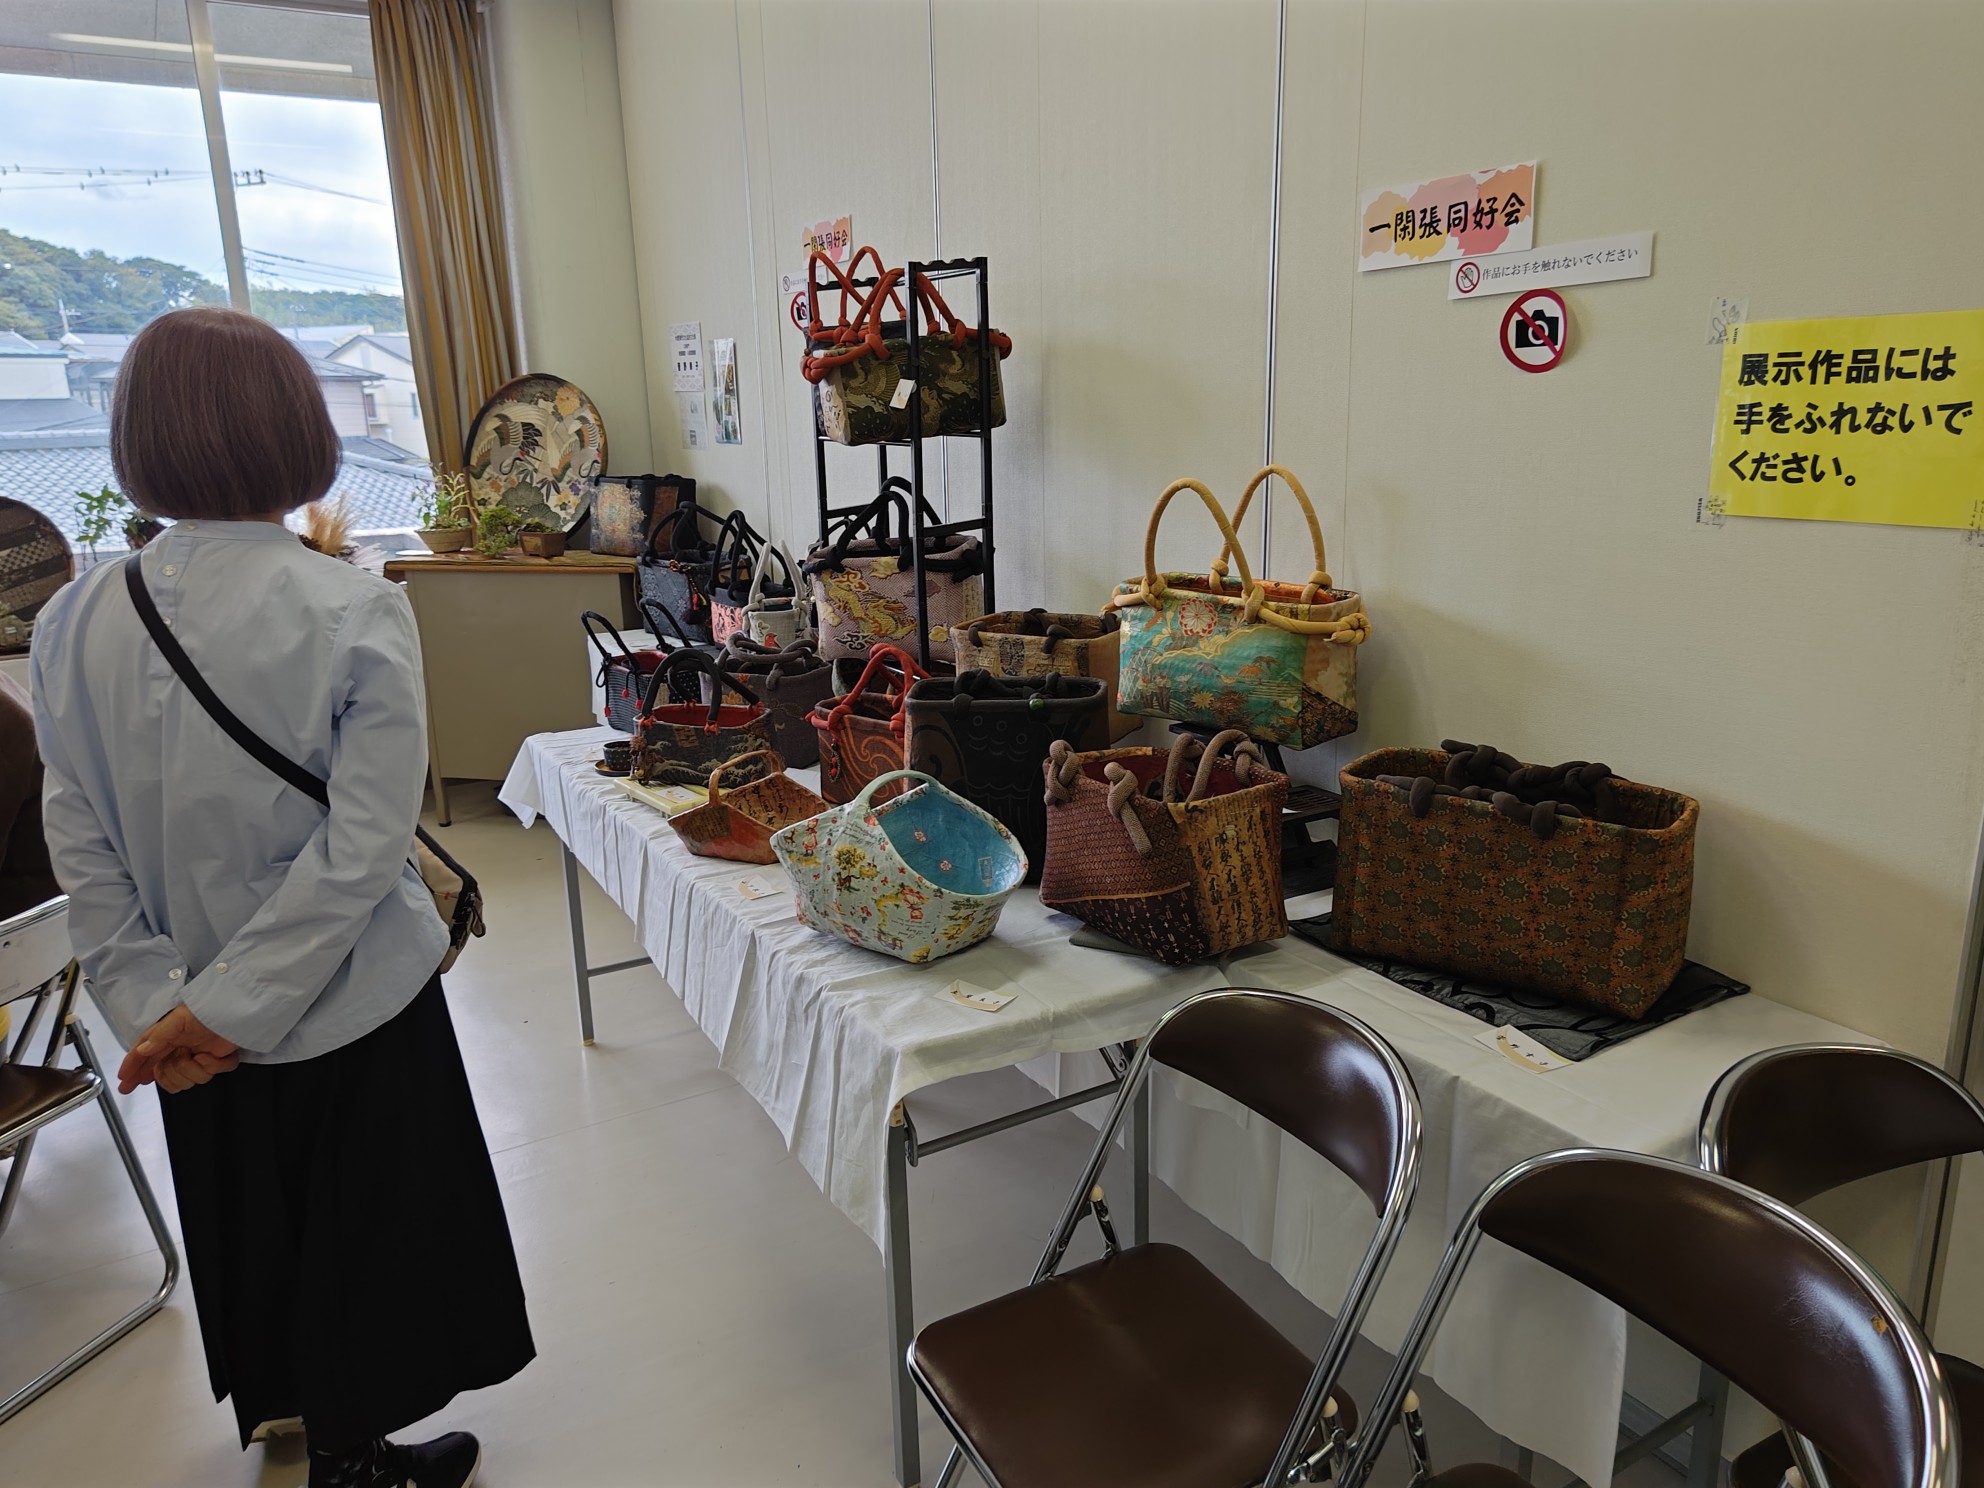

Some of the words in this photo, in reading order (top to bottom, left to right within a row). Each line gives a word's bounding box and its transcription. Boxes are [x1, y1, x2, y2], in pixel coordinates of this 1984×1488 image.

[1368, 192, 1526, 243] 一閑張同好会
[1482, 248, 1639, 281] 作品にお手を触れないでください
[1737, 345, 1957, 387] 展示作品には
[1733, 401, 1973, 435] 手をふれないで
[1728, 450, 1857, 487] ください。
